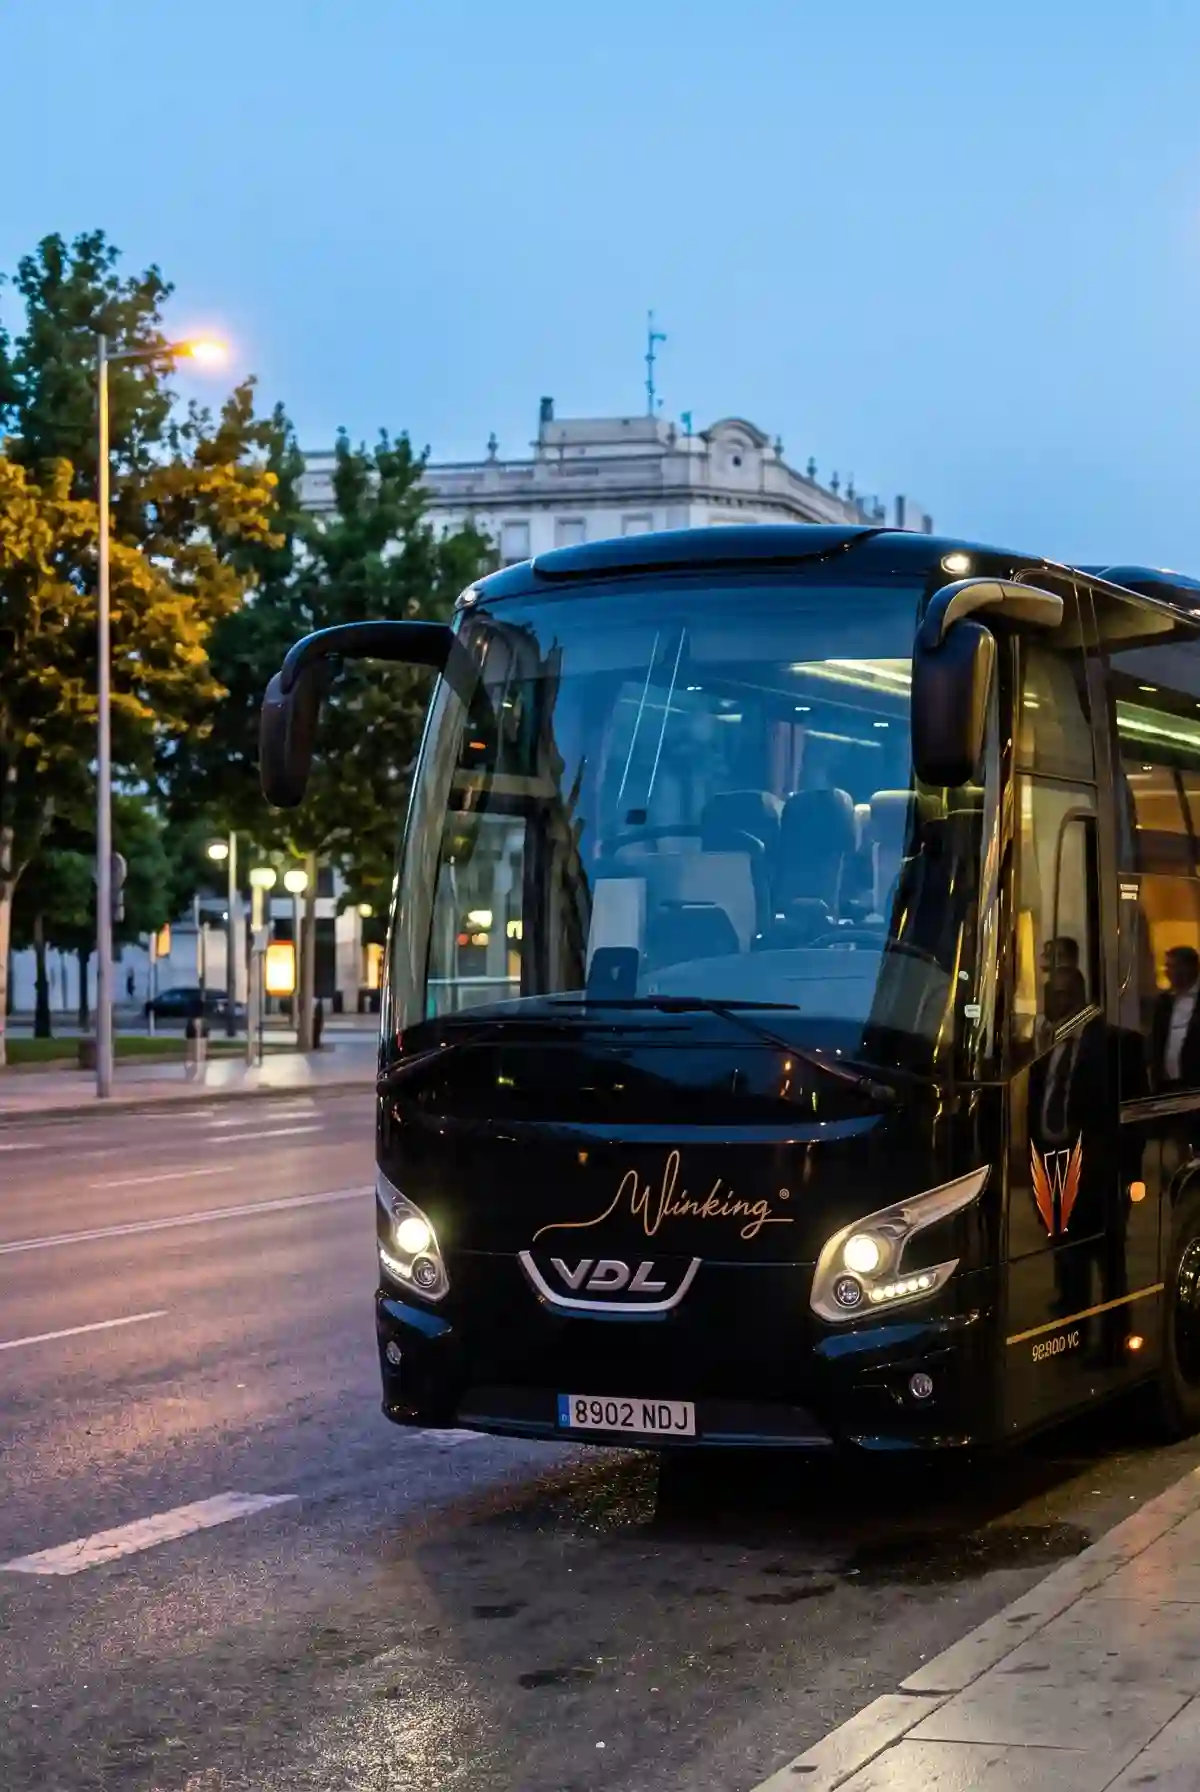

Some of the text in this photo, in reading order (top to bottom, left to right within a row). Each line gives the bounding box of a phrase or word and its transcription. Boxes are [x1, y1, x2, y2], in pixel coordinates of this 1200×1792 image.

[550, 1257, 667, 1292] VDL
[575, 1399, 688, 1430] 8902 NDJ
